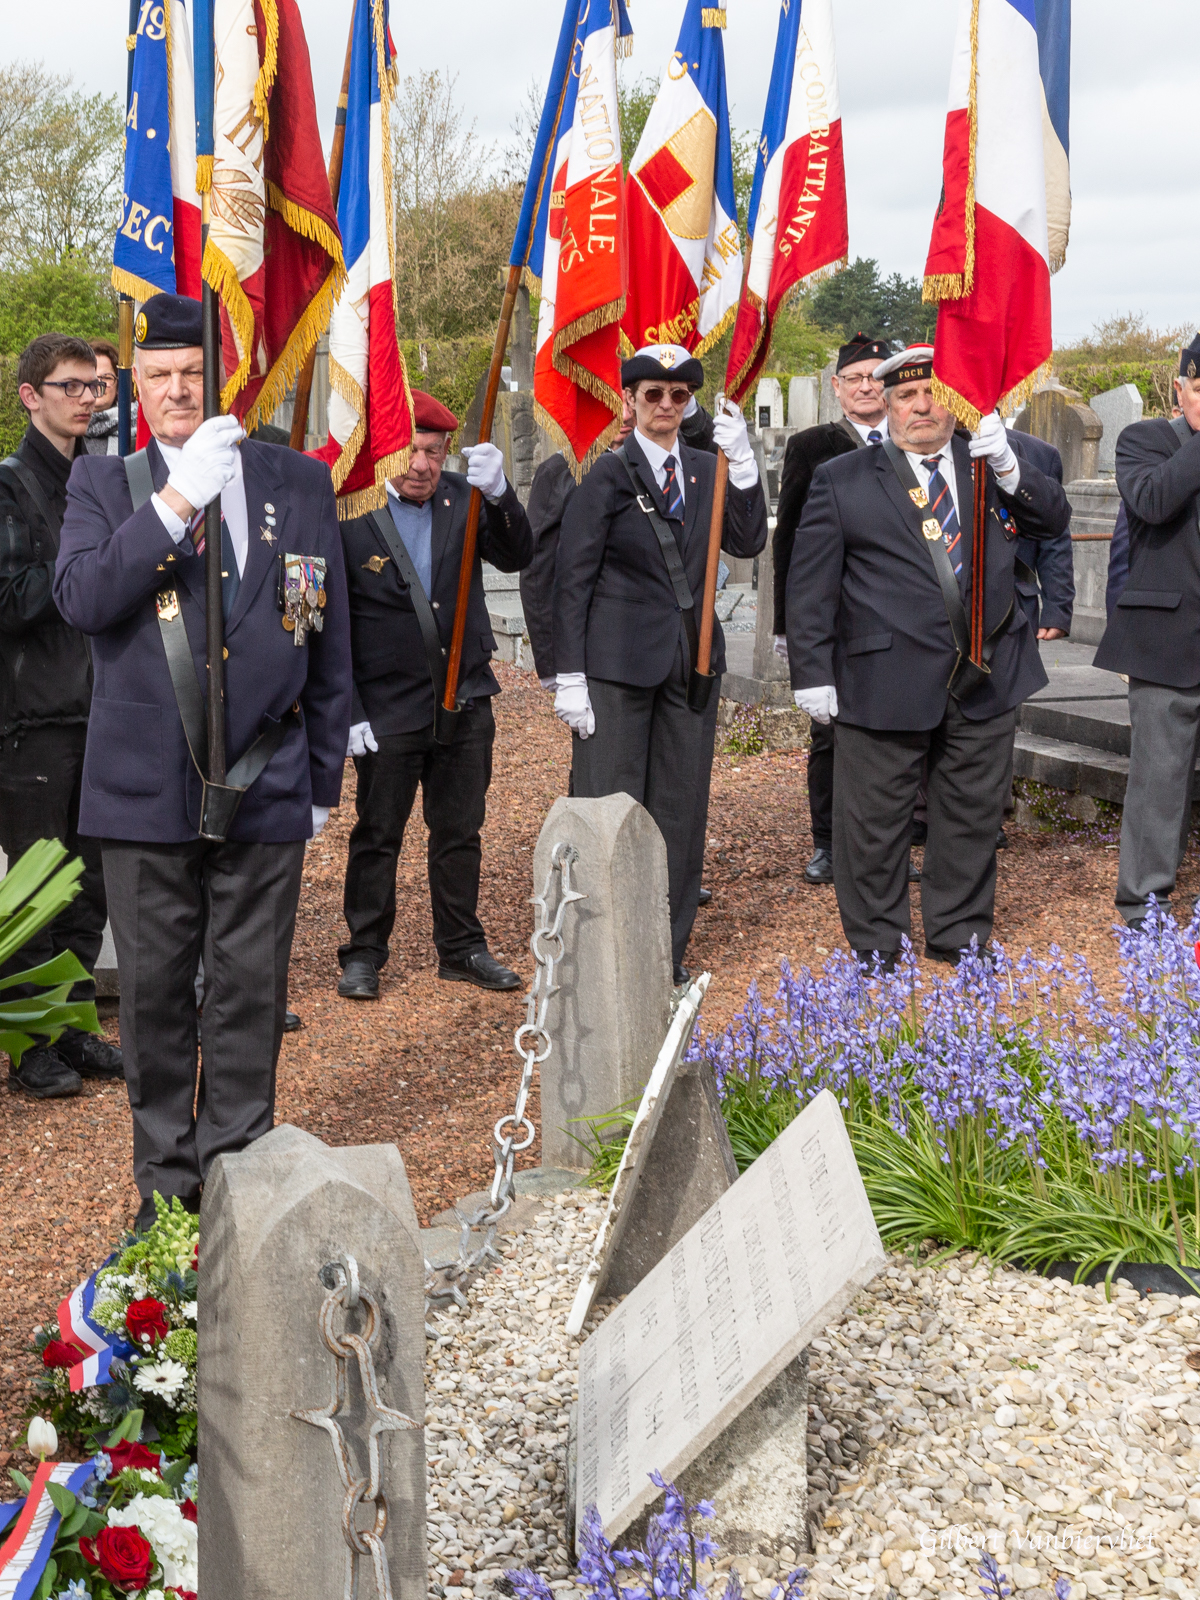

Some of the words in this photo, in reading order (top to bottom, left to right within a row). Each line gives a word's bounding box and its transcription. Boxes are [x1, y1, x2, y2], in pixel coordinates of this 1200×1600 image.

[577, 63, 618, 255] NATIONALE
[779, 62, 831, 259] COMBATTANTS
[899, 368, 924, 379] FOCH
[644, 1389, 663, 1444] 1944
